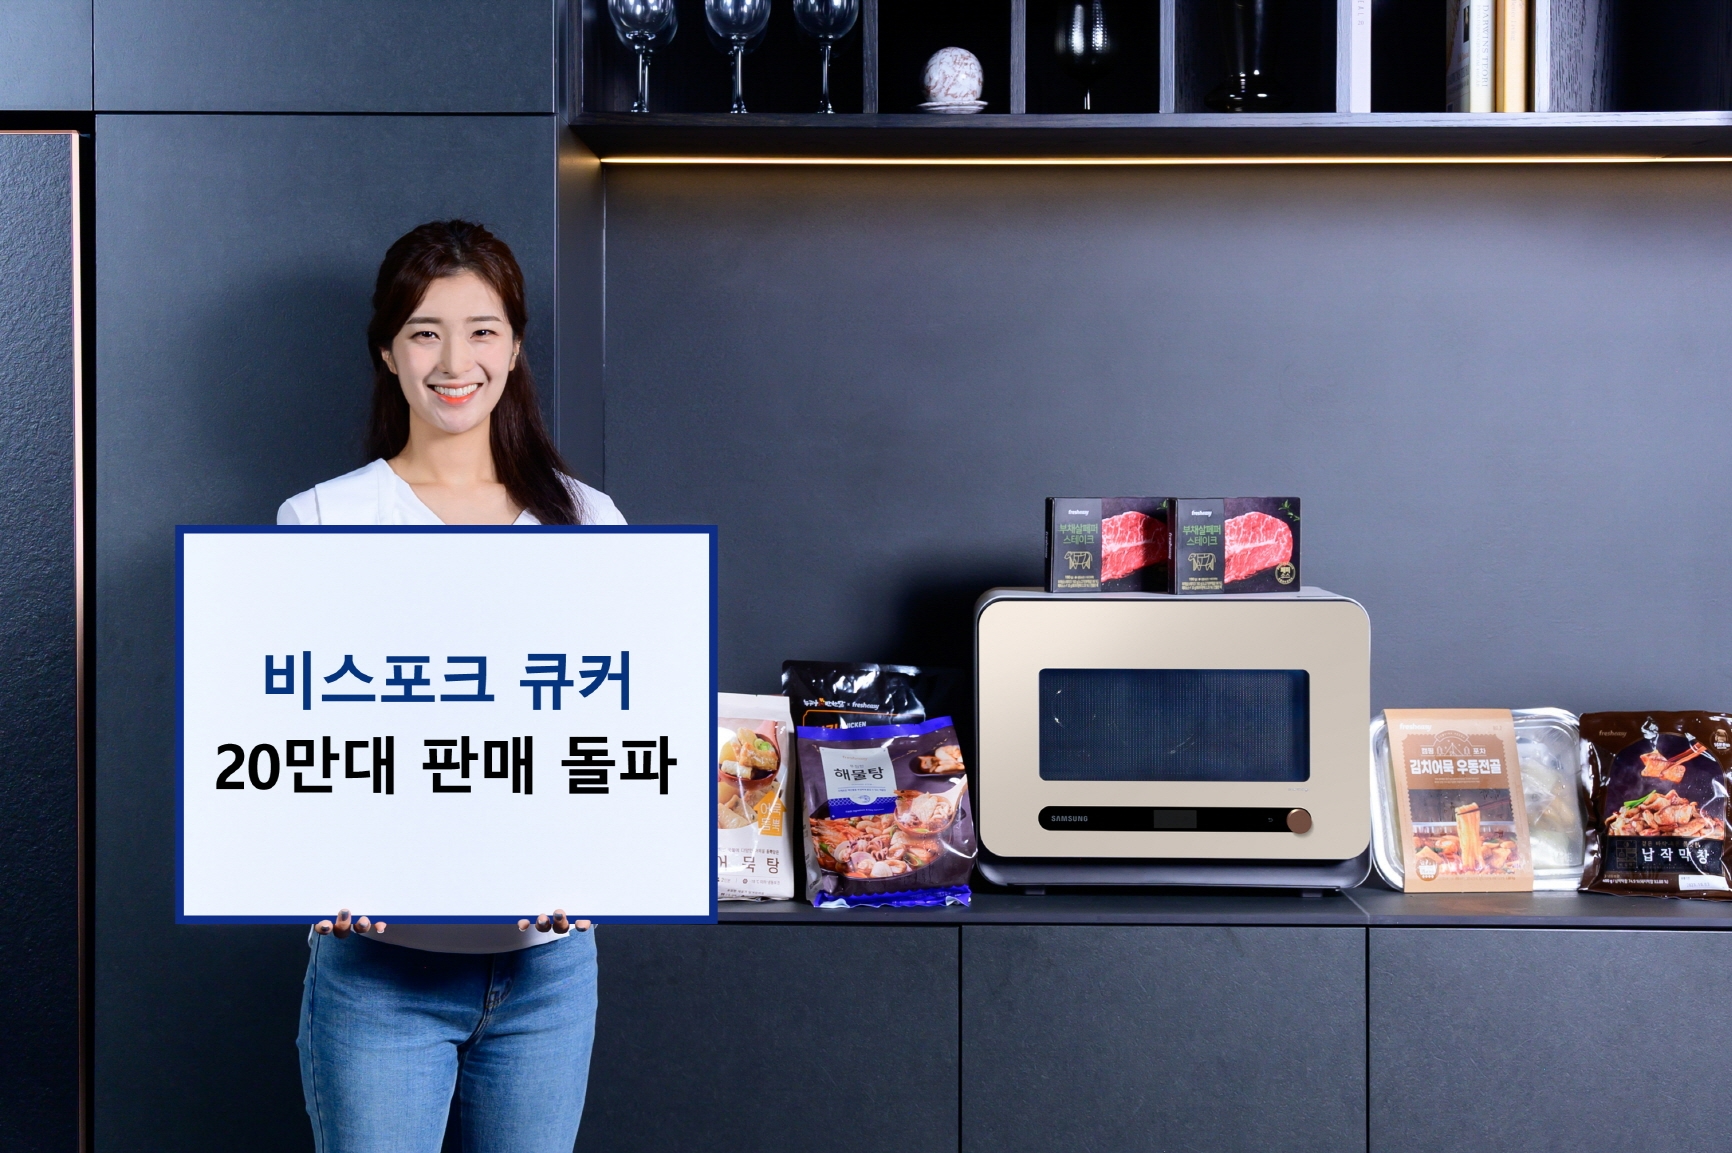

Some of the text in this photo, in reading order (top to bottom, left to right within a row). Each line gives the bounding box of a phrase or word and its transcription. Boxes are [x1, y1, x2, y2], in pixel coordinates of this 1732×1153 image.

[1481, 4, 1490, 88] DARWINS TEORI
[1182, 525, 1222, 536] 부채살페퍼
[1062, 535, 1095, 545] 스테이크
[1186, 536, 1218, 547] 스테이크
[264, 650, 631, 711] 비스포크 큐커
[852, 701, 880, 711] fresheasy
[1399, 722, 1433, 732] fresheasy
[1598, 729, 1628, 738] fresheasy
[1472, 747, 1487, 755] 포차
[215, 735, 678, 795] 20만대 판매 돌파
[1409, 758, 1502, 775] 김치어묵 우동전골
[833, 766, 885, 781] 해물탕
[1641, 847, 1710, 866] 납작막창
